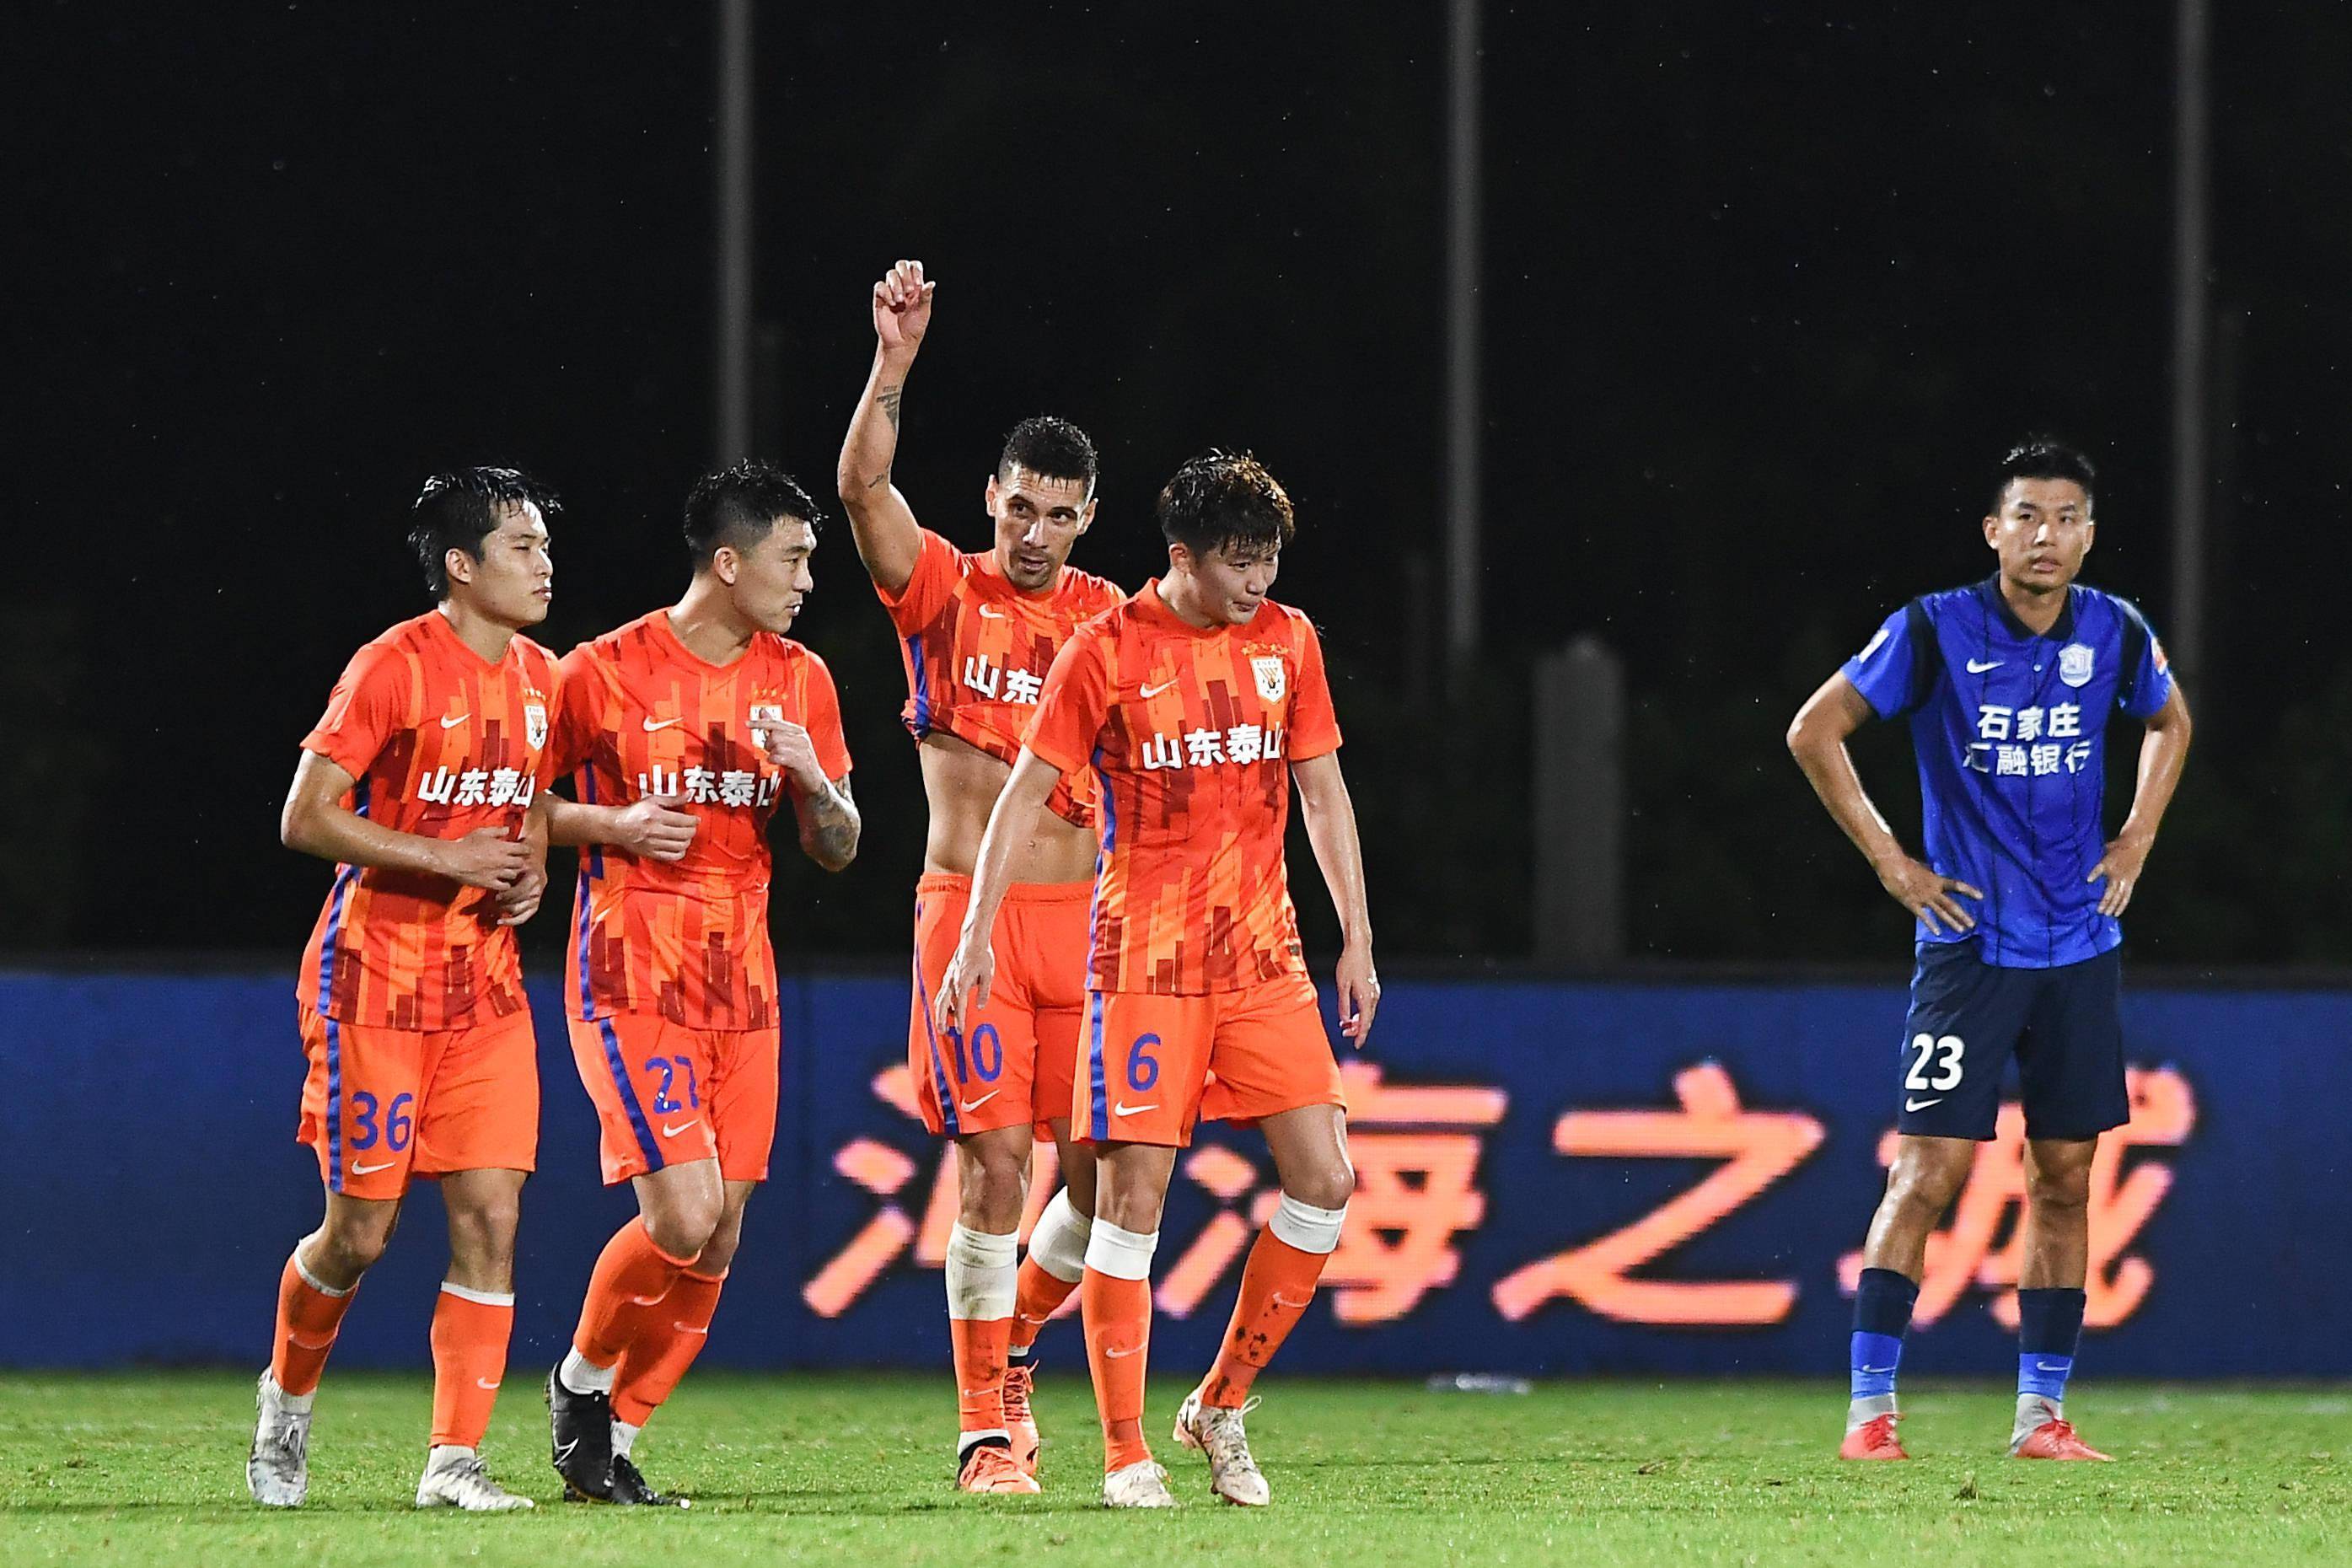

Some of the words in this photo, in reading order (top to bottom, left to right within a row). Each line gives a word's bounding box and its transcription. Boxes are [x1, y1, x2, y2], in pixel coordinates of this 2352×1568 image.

[964, 653, 1044, 706] 山东
[1141, 721, 1285, 771] 山东泰山
[1977, 701, 2081, 741] 石家庄
[1963, 740, 2091, 776] 汇融银行
[417, 765, 535, 808] 山东泰山
[947, 1023, 1003, 1084] 10
[1128, 1032, 1161, 1092] 6
[1904, 1034, 1965, 1091] 23
[645, 1055, 699, 1114] 27
[349, 1092, 413, 1152] 36
